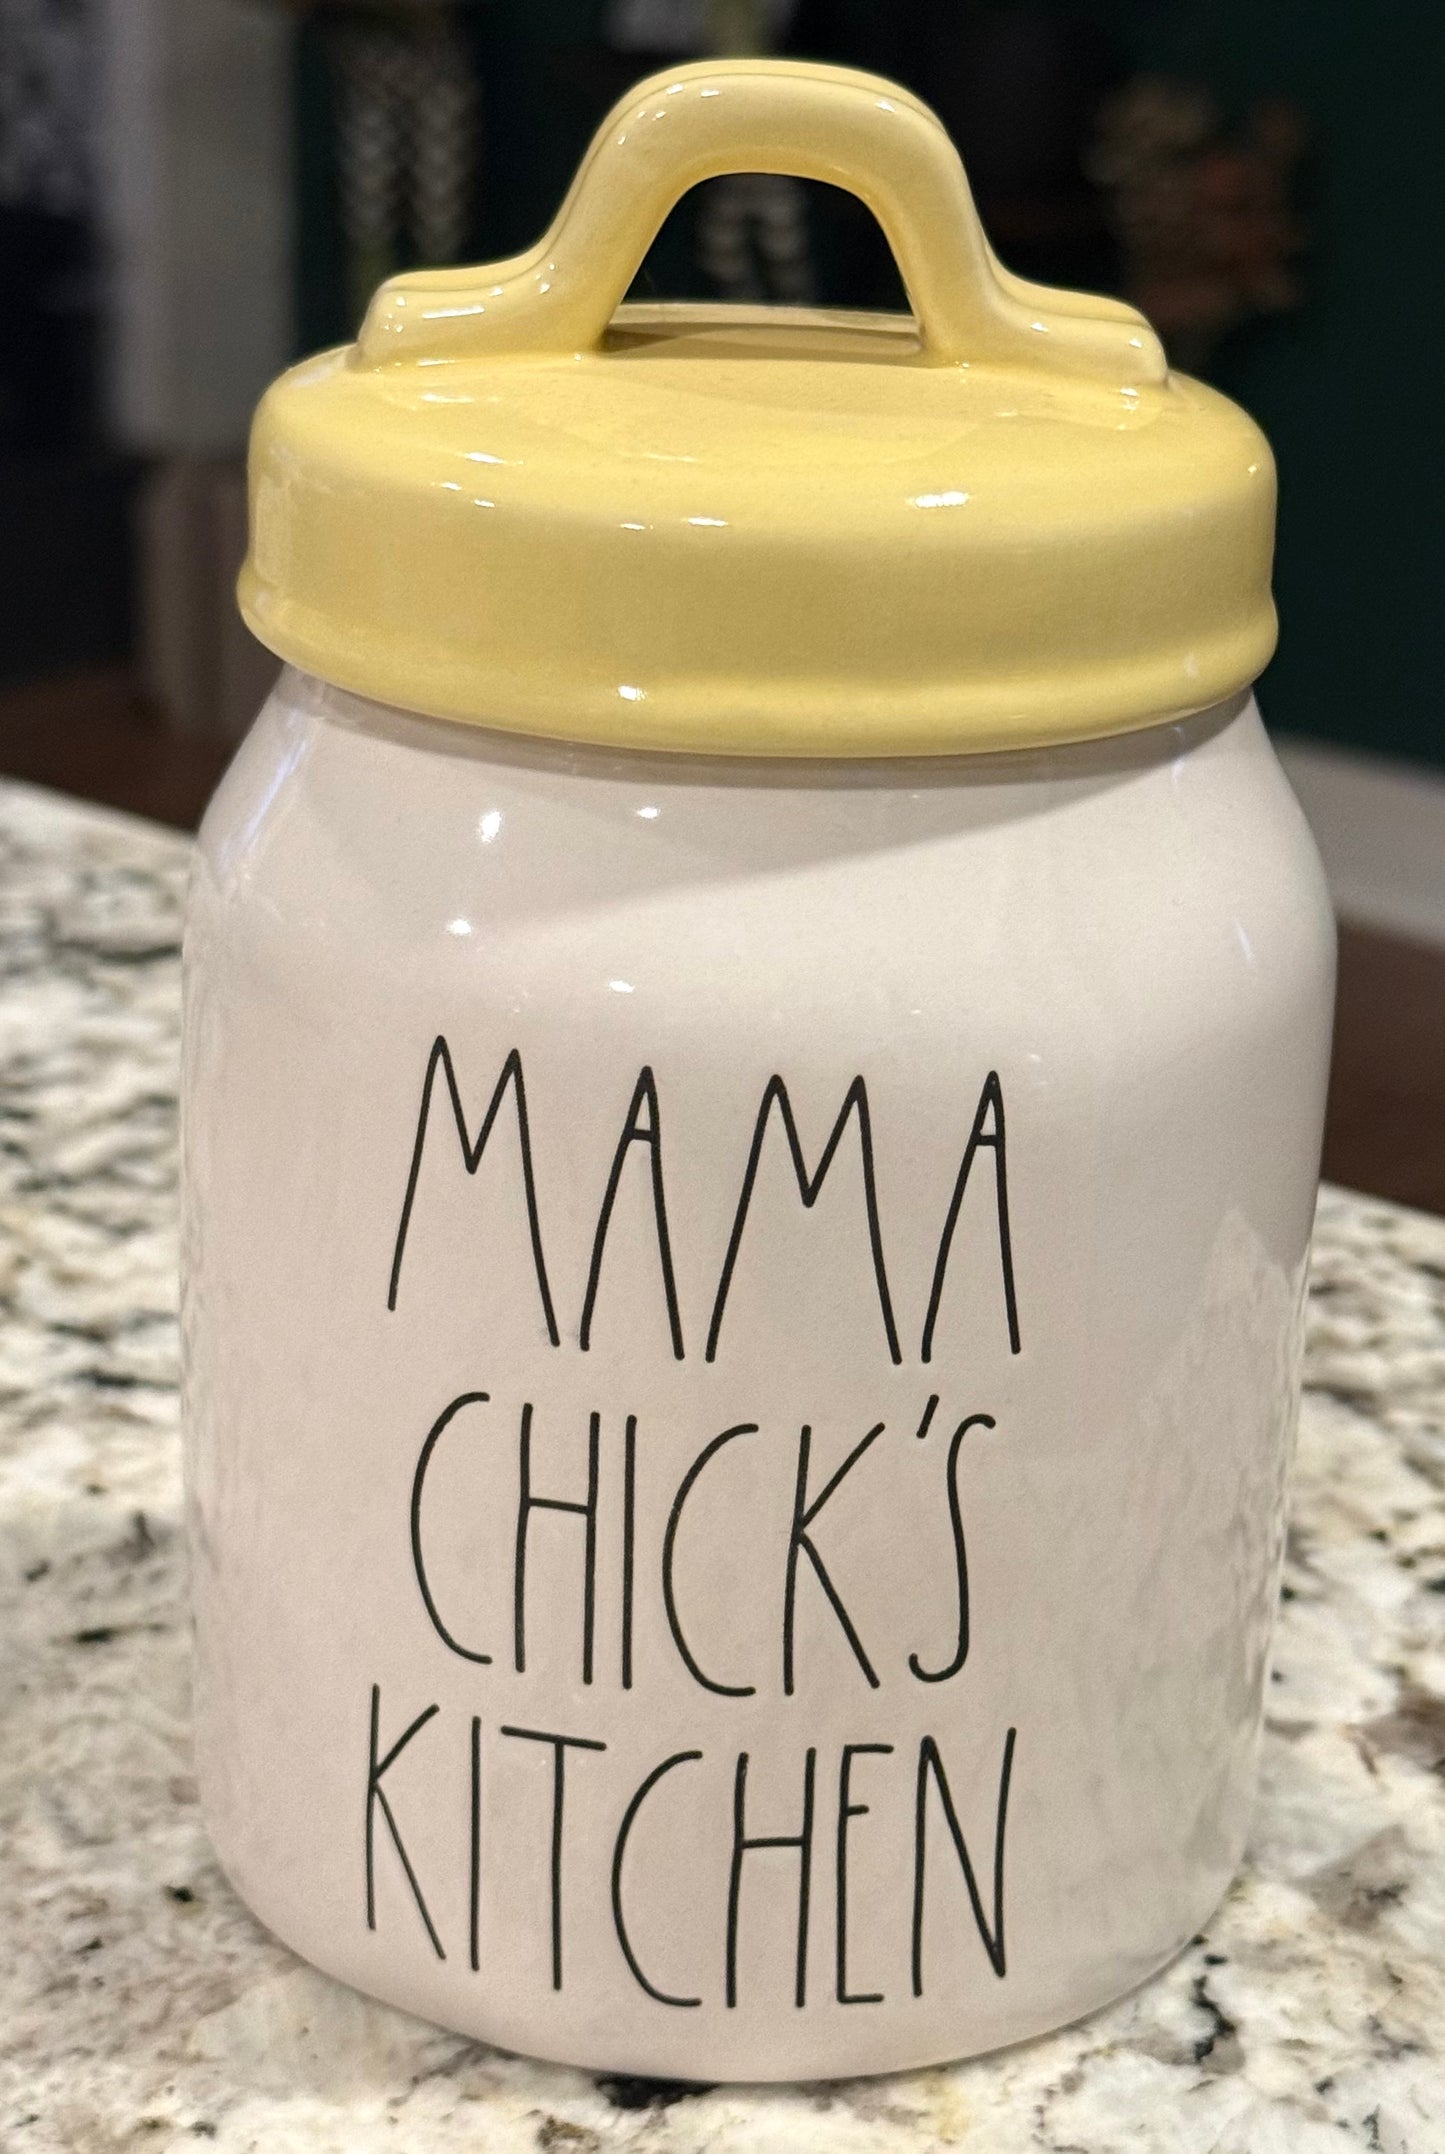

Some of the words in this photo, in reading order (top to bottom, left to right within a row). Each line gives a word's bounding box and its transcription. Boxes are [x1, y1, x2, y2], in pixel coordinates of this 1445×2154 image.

[389, 1036, 1021, 1363] MAMA
[411, 1392, 996, 1697] CHICK'S
[366, 1684, 1016, 2008] KITCHEN
